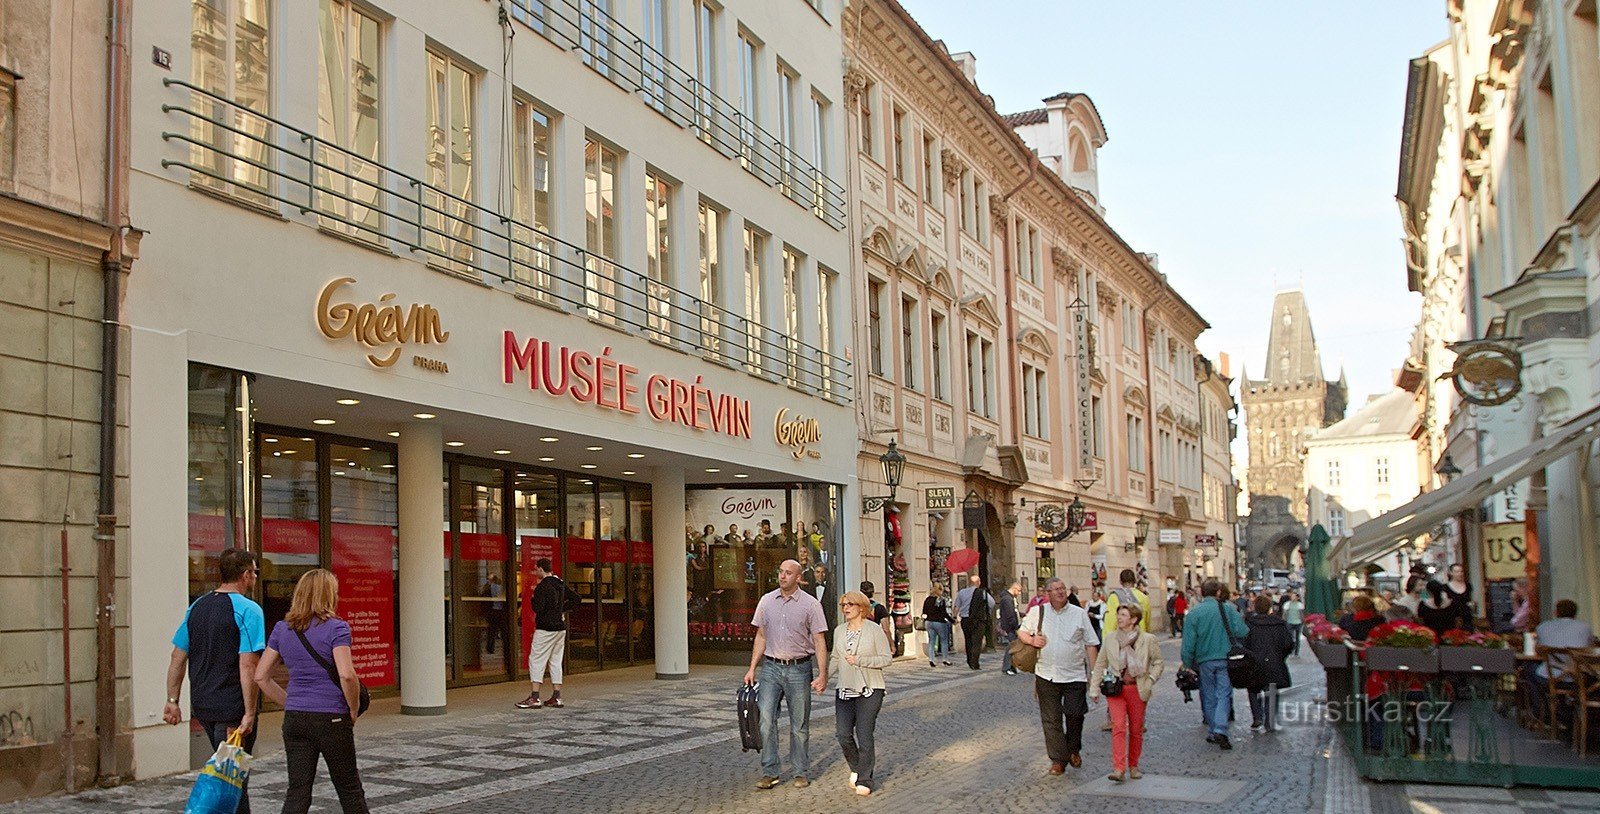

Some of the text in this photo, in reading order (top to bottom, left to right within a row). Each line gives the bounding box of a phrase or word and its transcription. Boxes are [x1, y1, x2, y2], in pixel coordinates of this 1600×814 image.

[1076, 314, 1086, 379] DIVADLO
[413, 355, 449, 373] PRAHA
[503, 330, 751, 440] MUSÉE GRÉVIN
[928, 488, 952, 498] SLEVA
[928, 500, 952, 508] SALE
[1488, 536, 1526, 563] US
